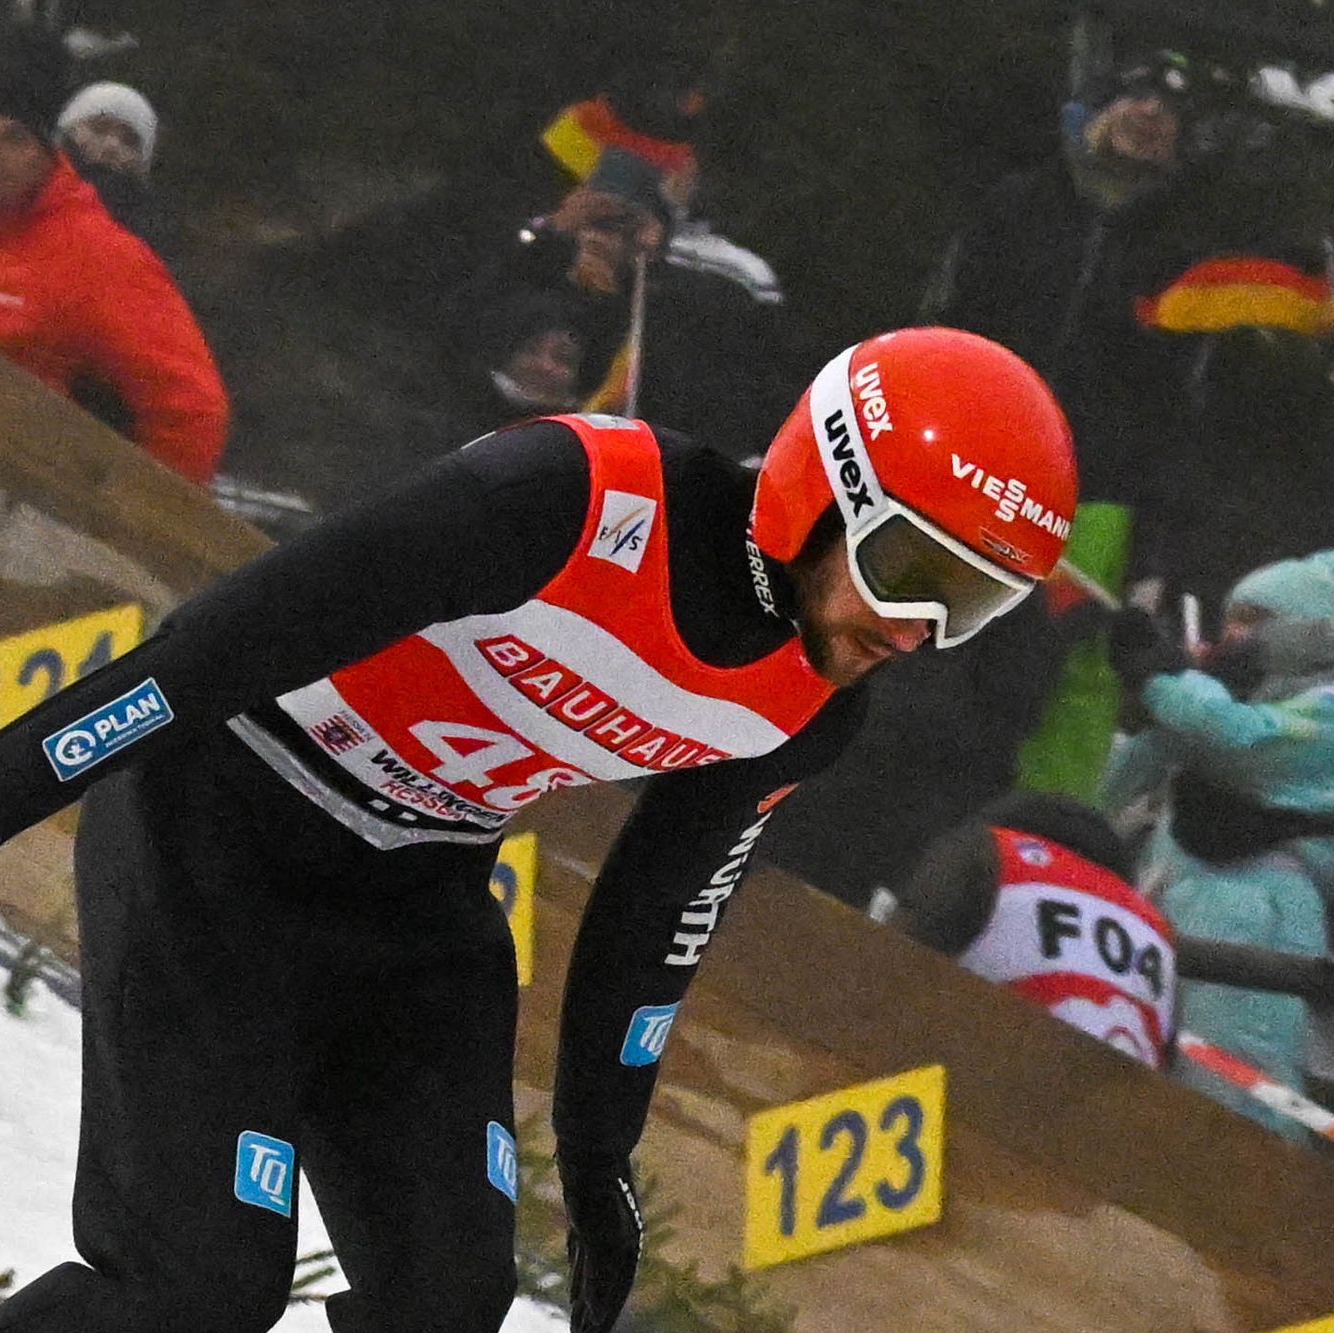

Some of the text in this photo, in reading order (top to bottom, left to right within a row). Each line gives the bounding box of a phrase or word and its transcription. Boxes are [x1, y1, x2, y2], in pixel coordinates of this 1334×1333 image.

[855, 362, 893, 441] uvex
[823, 408, 875, 519] uvex
[746, 527, 780, 618] ERREX
[94, 692, 161, 741] PLAN
[765, 1095, 924, 1237] 123
